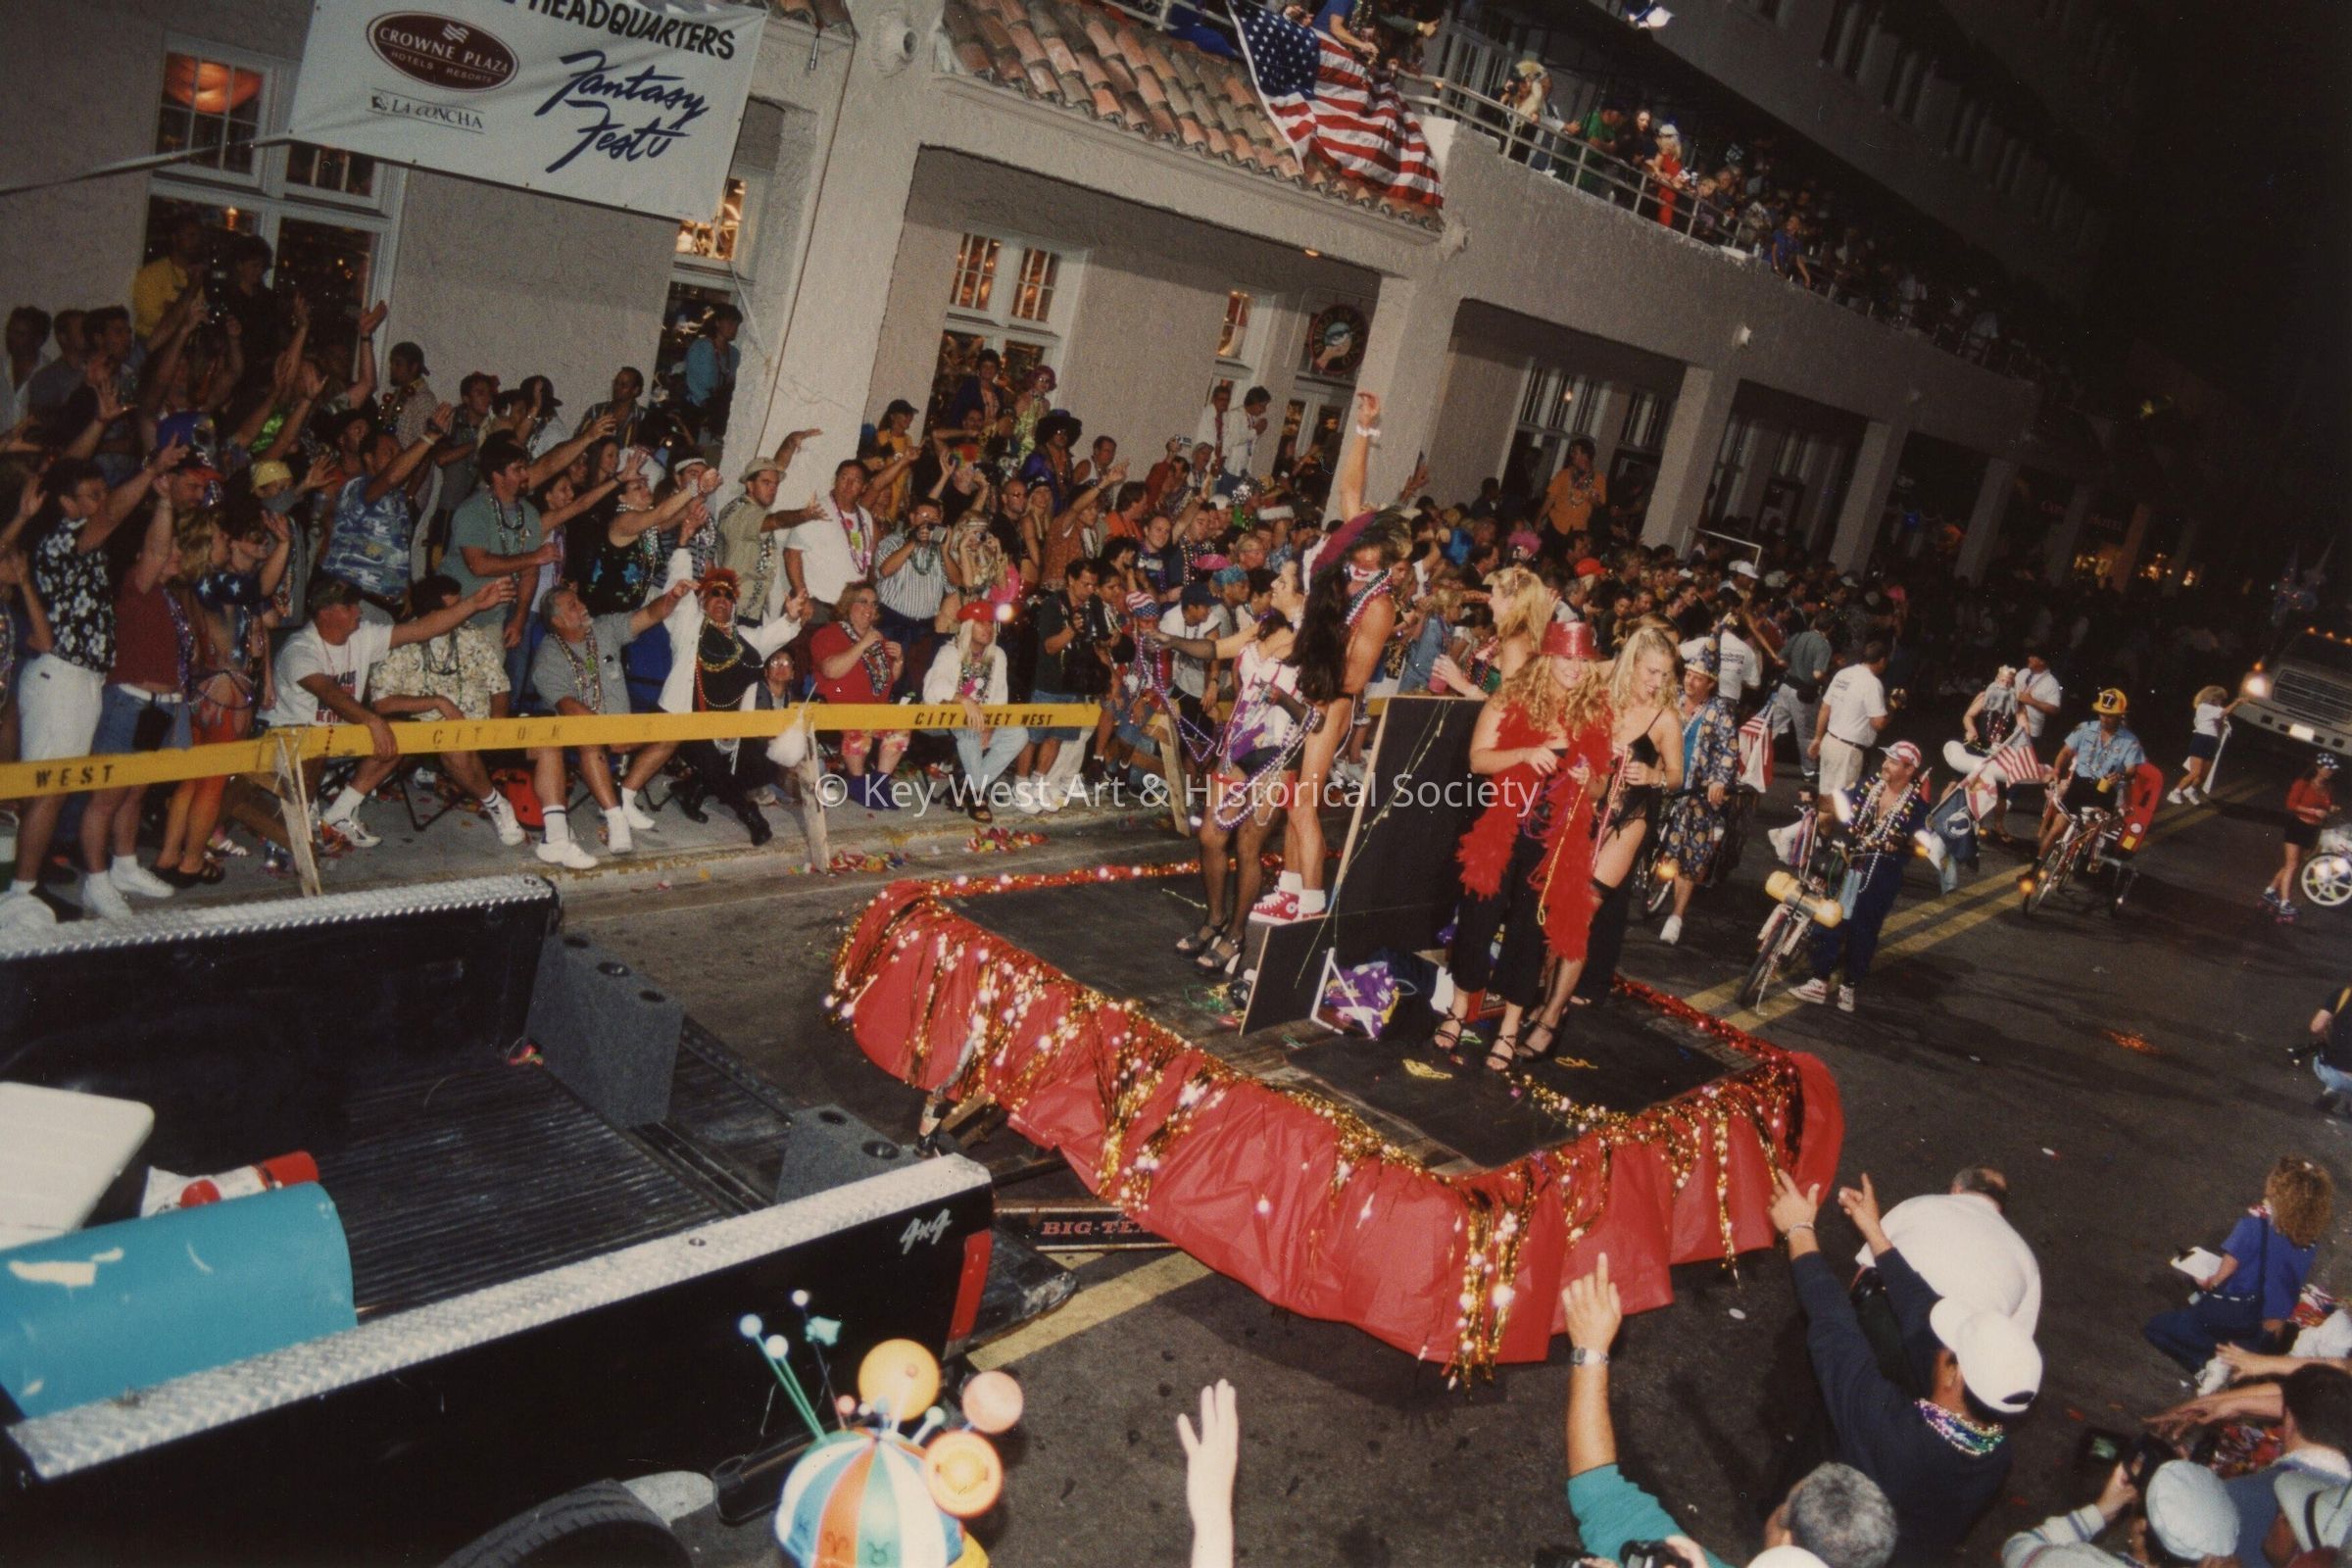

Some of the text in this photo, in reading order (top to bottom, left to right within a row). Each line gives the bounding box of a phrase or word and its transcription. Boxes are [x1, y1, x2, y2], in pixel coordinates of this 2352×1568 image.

[379, 27, 509, 74] CROWNE PLAZA
[392, 51, 434, 71] HOTELS
[534, 50, 710, 131] Fantasy
[392, 99, 411, 114] LA
[914, 711, 957, 726] CITY
[1020, 713, 1054, 726] WEST
[35, 764, 114, 789] WEST
